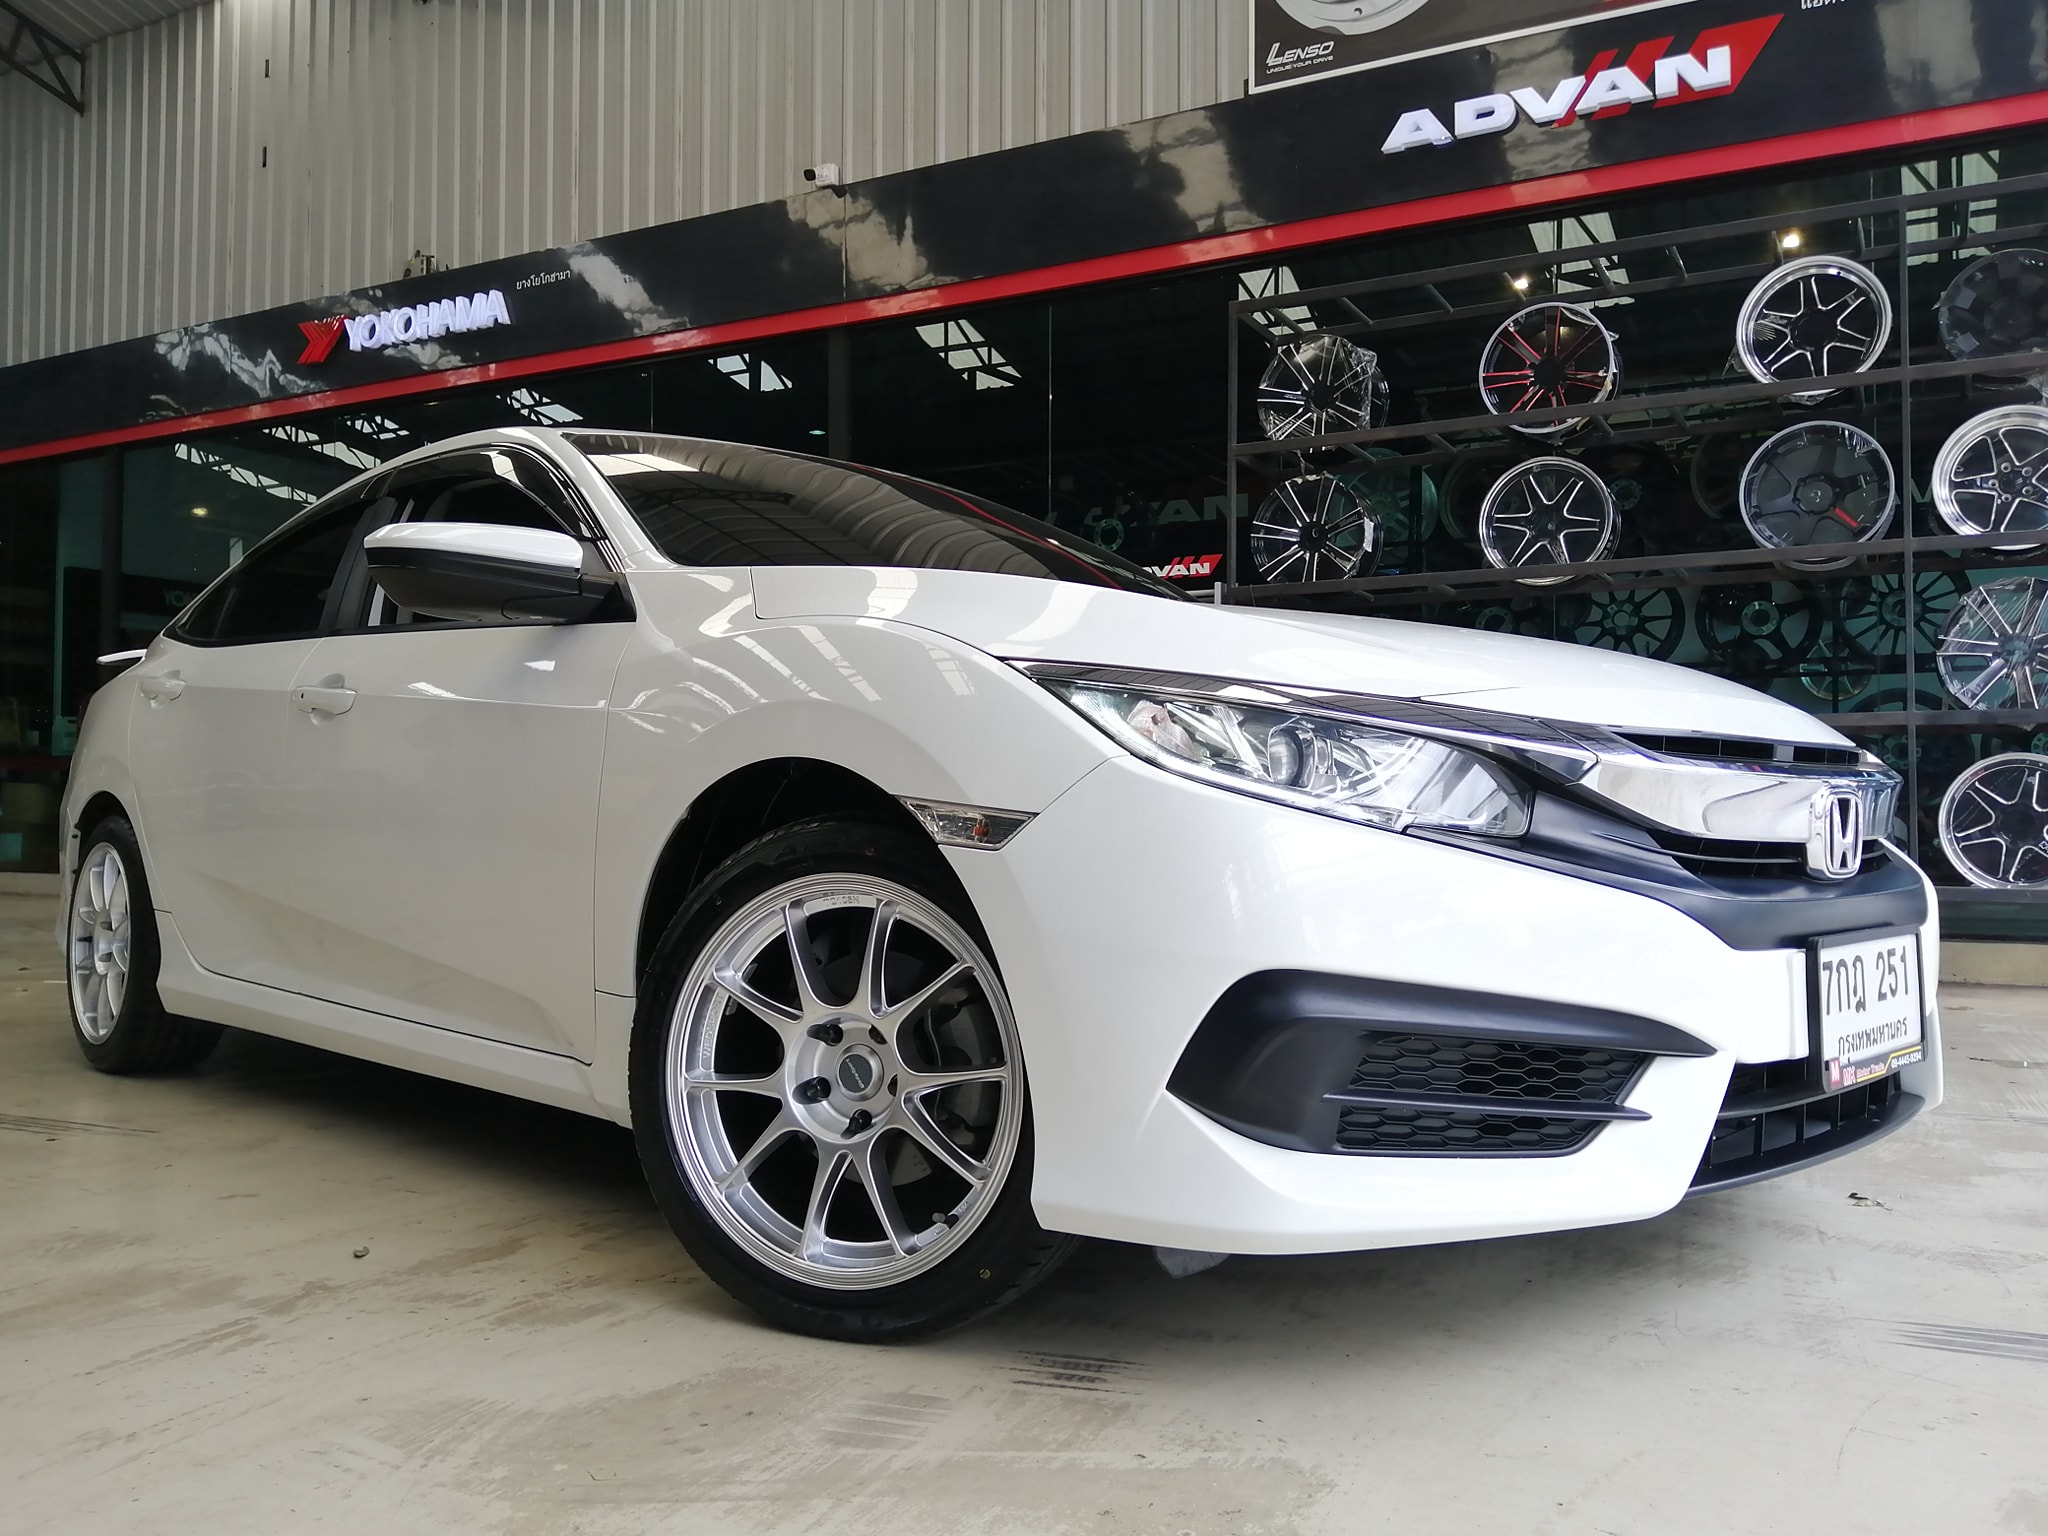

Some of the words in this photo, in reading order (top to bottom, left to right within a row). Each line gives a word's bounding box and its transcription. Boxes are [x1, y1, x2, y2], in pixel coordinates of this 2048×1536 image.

[1266, 41, 1335, 67] LENSO
[1266, 64, 1292, 75] UNIQUE
[1293, 60, 1312, 69] YOUR
[1381, 45, 1732, 154] ADVAN
[516, 270, 571, 290] ยางโยโกฮามา
[344, 289, 512, 351] YOKOHAMA
[1876, 946, 1909, 1002] 251
[1838, 1017, 1908, 1065] กรุงเทพมหานคร
